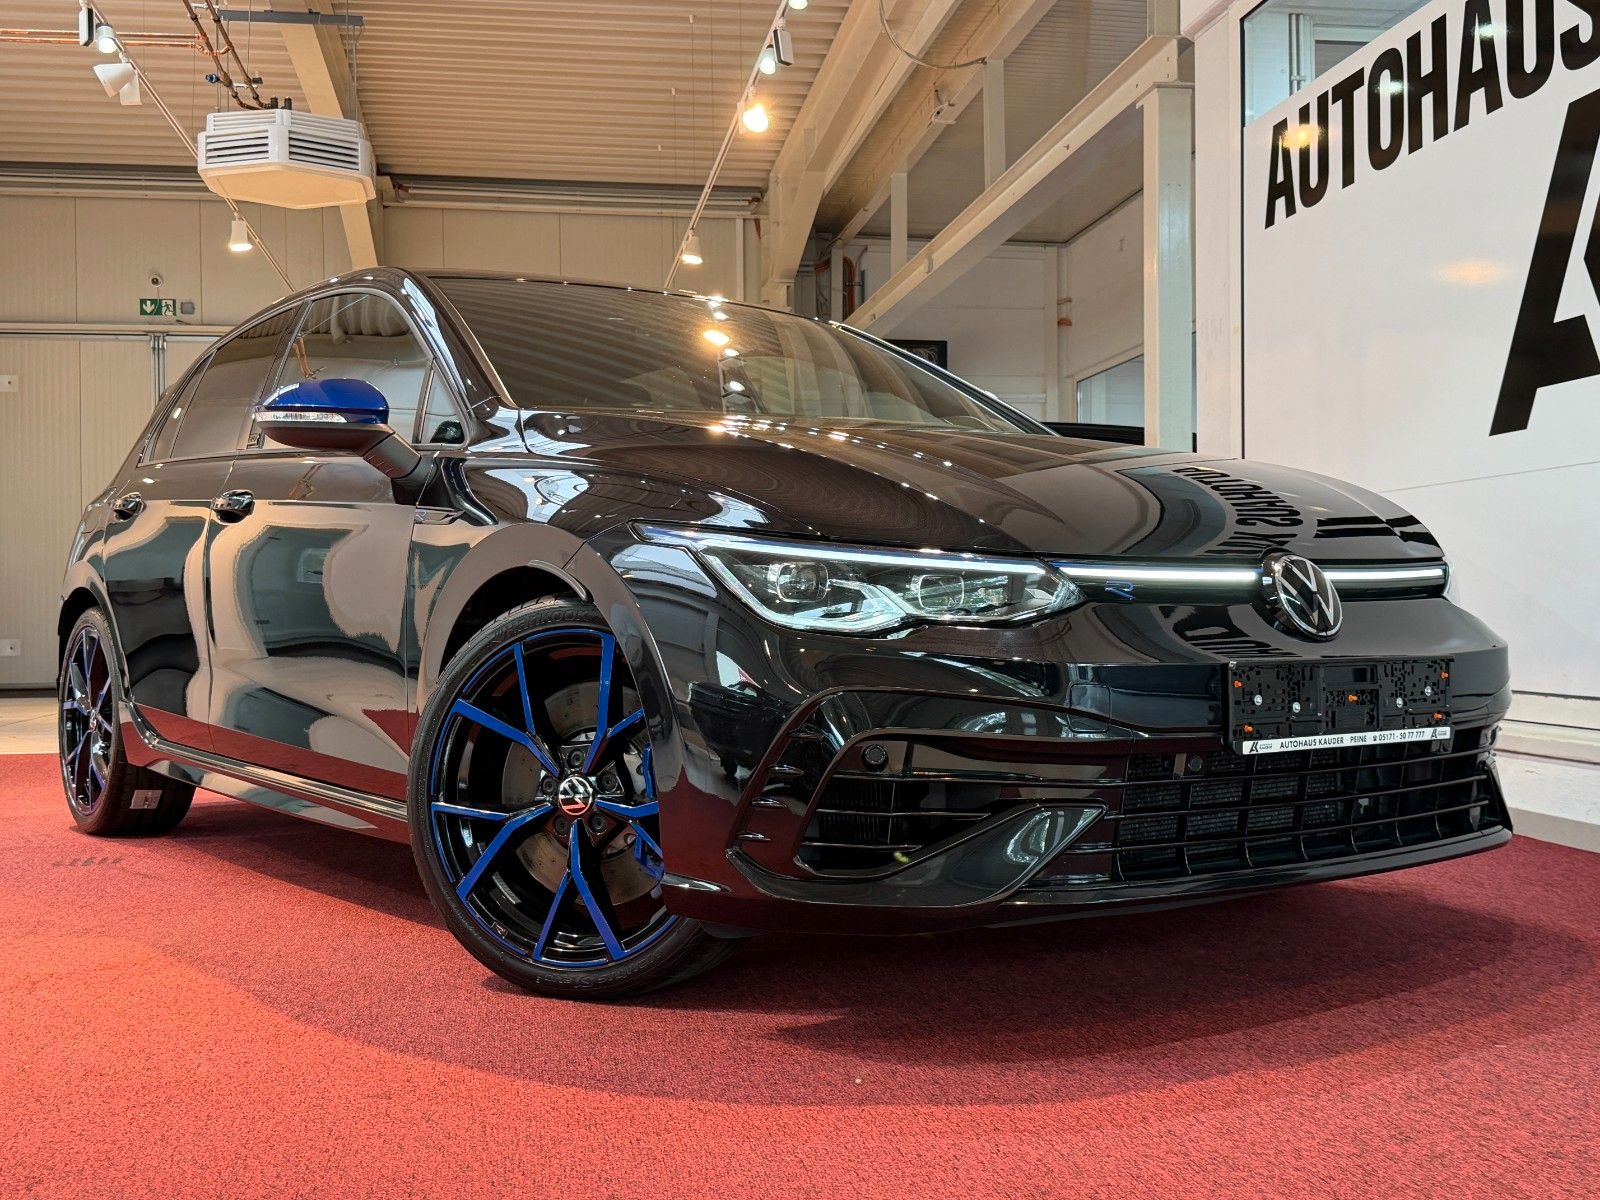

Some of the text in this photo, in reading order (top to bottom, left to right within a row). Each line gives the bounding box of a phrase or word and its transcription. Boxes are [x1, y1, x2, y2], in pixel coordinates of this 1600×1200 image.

[1104, 580, 1136, 600] R
[1280, 738, 1317, 749] AUTOHAUS
[1318, 736, 1344, 746] KAUDER
[1350, 735, 1367, 743] PEINE
[1378, 732, 1395, 741] 05171
[1399, 731, 1406, 740] 50
[1407, 731, 1414, 739] 77
[1415, 730, 1425, 738] 777
